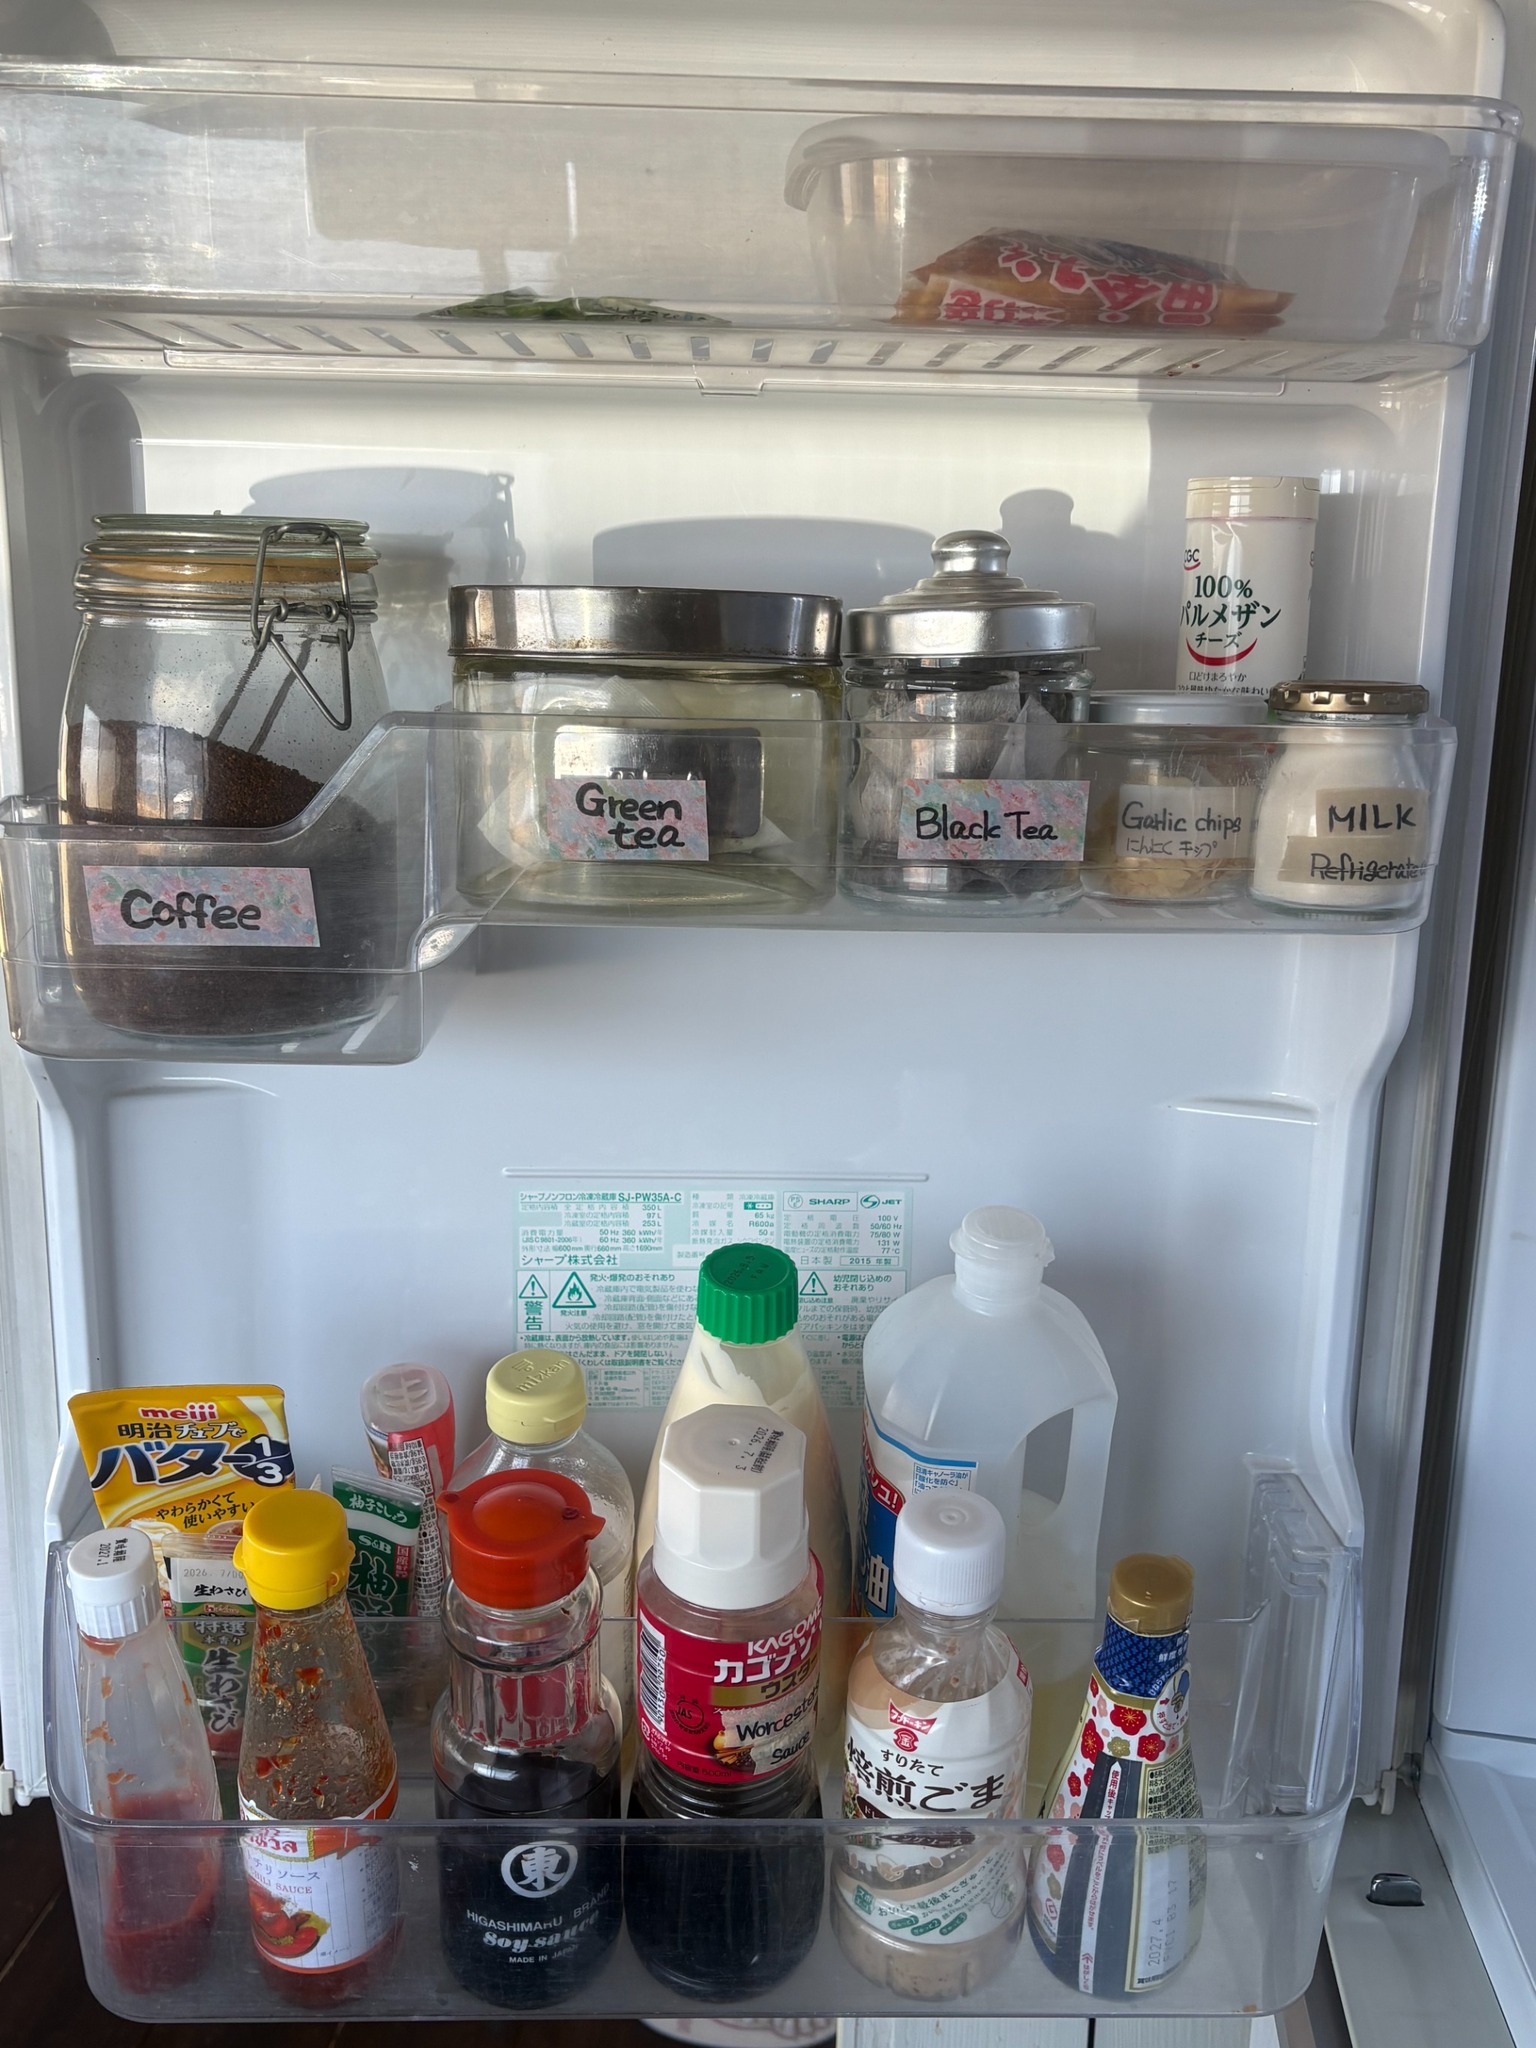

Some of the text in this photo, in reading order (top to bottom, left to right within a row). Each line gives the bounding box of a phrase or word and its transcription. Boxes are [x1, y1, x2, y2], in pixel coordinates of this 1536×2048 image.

[1194, 575, 1253, 598] 100%
[1180, 600, 1281, 629] パルメザン
[1195, 632, 1242, 648] チーズ
[1189, 671, 1247, 682] 口どけまろやか
[576, 782, 682, 821] Green
[916, 804, 1058, 841] Black Tea
[1122, 801, 1241, 839] Garlic chips
[1328, 803, 1416, 832] MILK
[608, 822, 685, 849] tea
[120, 888, 262, 930] Coffee
[618, 1192, 682, 1202] SJ-PW35A-C
[870, 1222, 892, 1230] 50/60
[893, 1222, 902, 1230] Hz
[521, 1254, 618, 1266] シャープ株式会社
[833, 1283, 874, 1292] おそれあり
[524, 1301, 544, 1331] 警告
[141, 1404, 218, 1420] meiji
[118, 1421, 248, 1440] 明治チューブで
[90, 1442, 257, 1490] バター
[916, 1466, 968, 1479] 日清キャノーラ油が
[156, 1491, 237, 1520] やわらかくて
[183, 1501, 255, 1529] 使いやすい
[349, 1494, 408, 1523] 柚子こしょう
[358, 1535, 392, 1554] S&B
[183, 1569, 212, 1578] 2026.
[194, 1584, 248, 1598] 生わさび
[748, 1597, 822, 1656] KAGOME
[204, 1647, 245, 1733] 生わさび
[770, 1731, 811, 1765] Sauce
[848, 1737, 1005, 1813] 焙煎ごま
[881, 1749, 944, 1777] すりたて
[253, 1857, 320, 1881] チリソース
[517, 1847, 567, 1891] 東
[276, 1883, 313, 1894] SAUCE
[466, 1882, 610, 1933] HIGASHIMARU BRAND
[483, 1910, 600, 1953] Soy sauce
[552, 1944, 579, 1959] JAPAN
